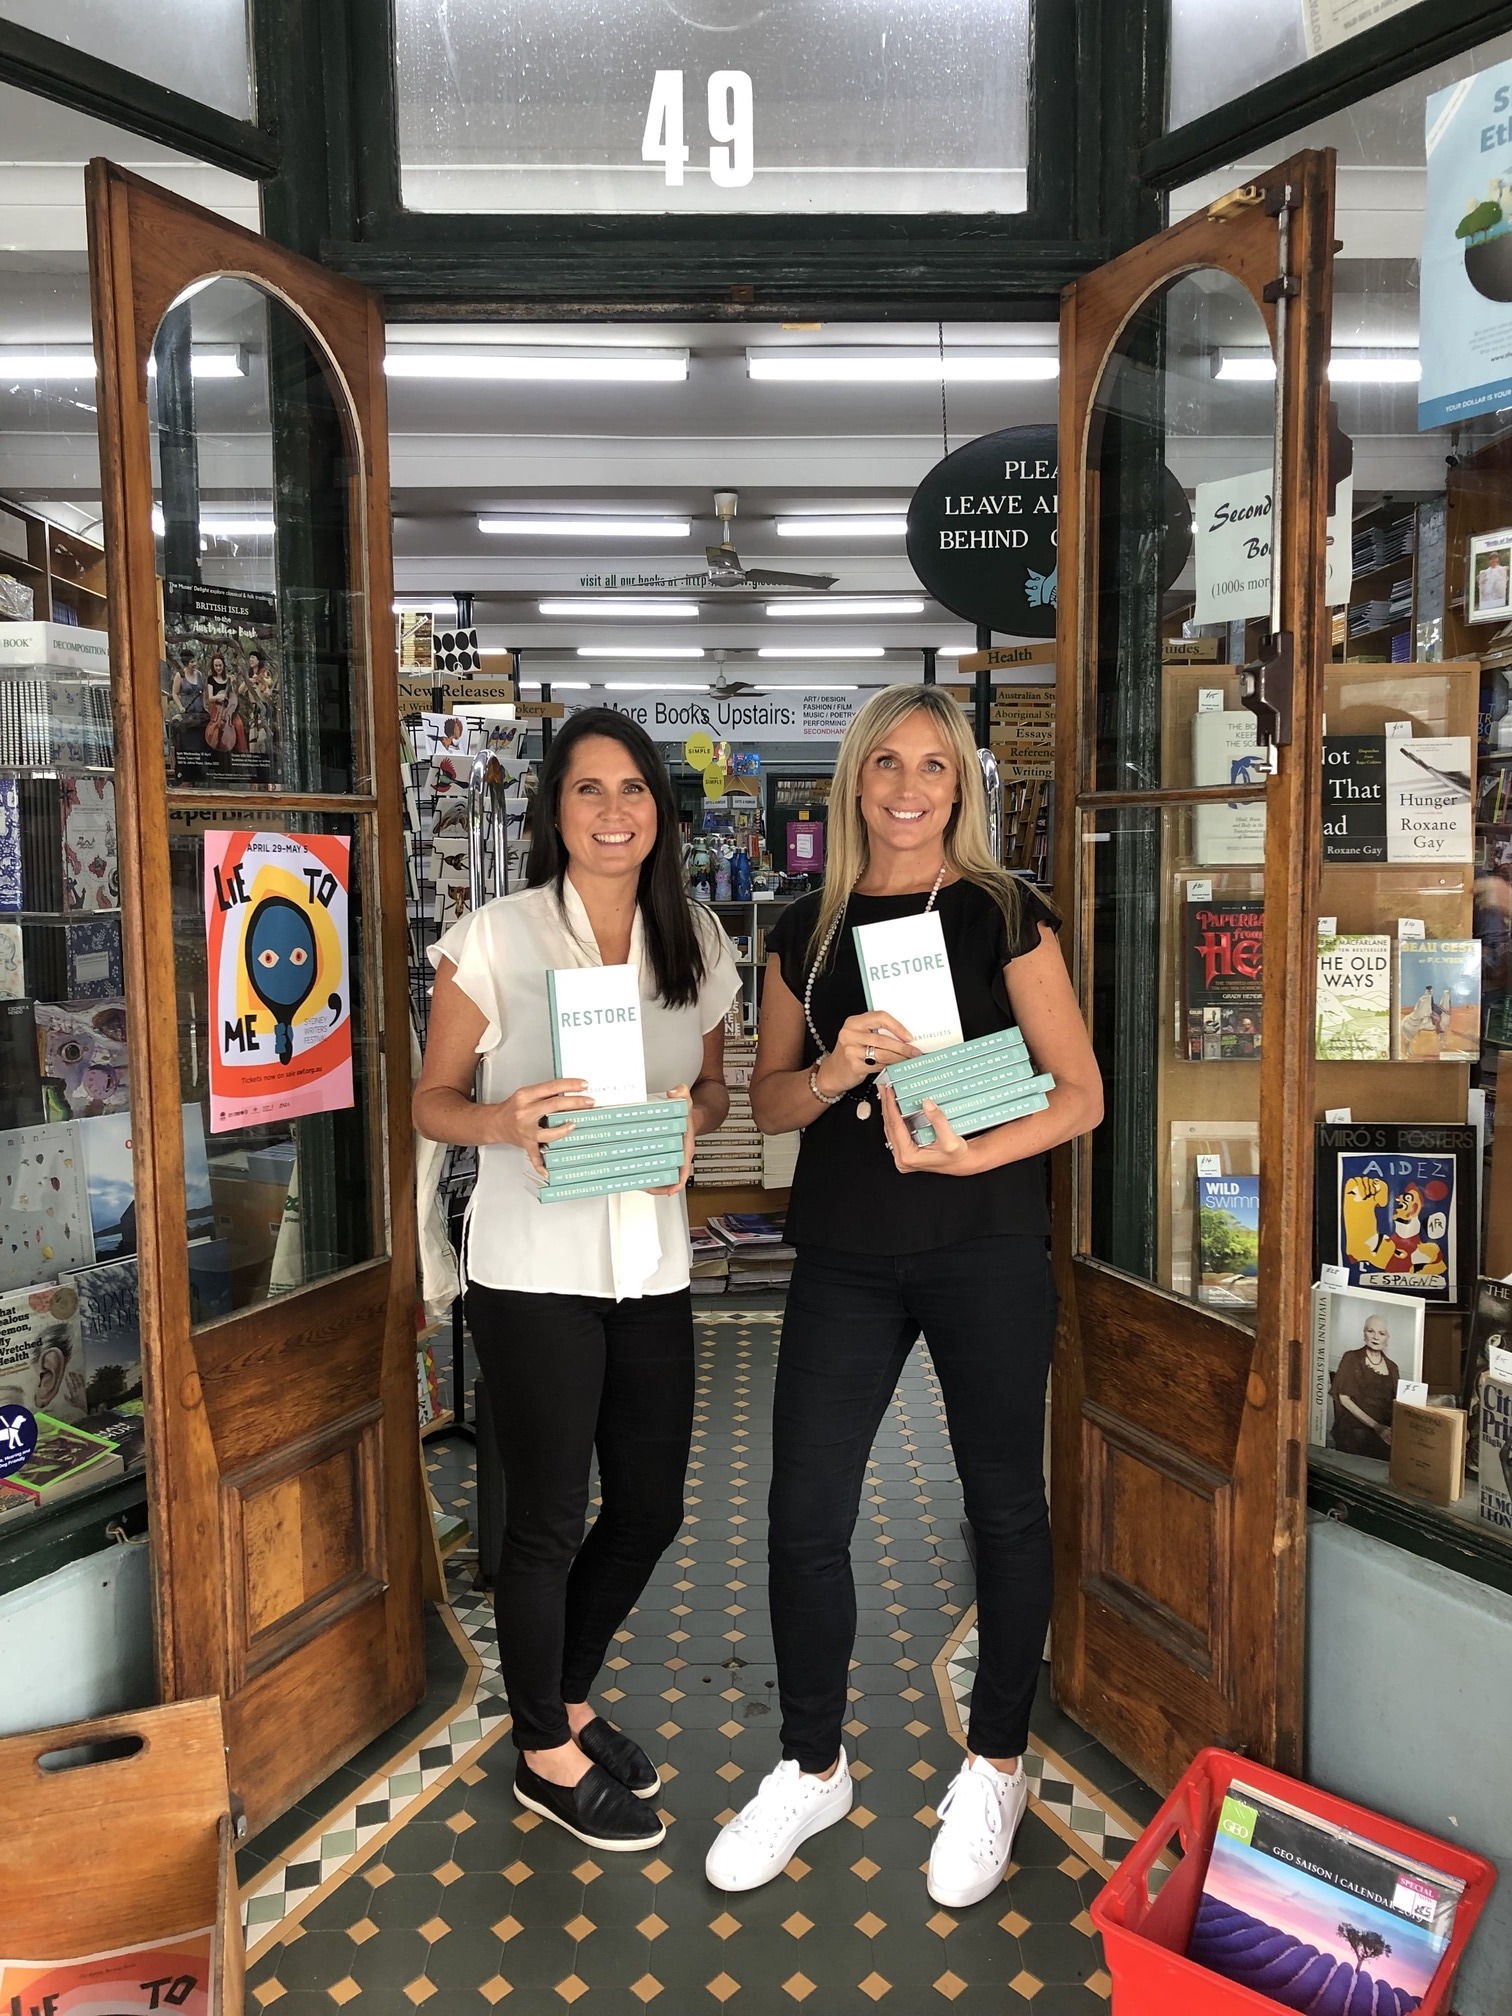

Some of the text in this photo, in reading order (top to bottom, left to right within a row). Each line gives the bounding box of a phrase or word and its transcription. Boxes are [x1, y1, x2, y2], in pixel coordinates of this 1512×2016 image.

[1493, 85, 1512, 113] S
[641, 70, 754, 188] 49
[1445, 389, 1511, 412] YOUR DOLLAR IS YOUR
[944, 495, 1023, 515] LEAVE
[939, 529, 1029, 549] BEHIND
[580, 574, 602, 586] visit
[604, 574, 617, 588] all
[620, 577, 636, 587] our
[195, 601, 249, 616] BRITISH ISLES
[192, 620, 237, 638] Australian
[53, 640, 107, 656] DECOMPOSITION
[987, 648, 1032, 665] Health
[399, 683, 505, 698] New Releases
[998, 691, 1041, 700] Australian
[603, 702, 796, 730] More Books Upstairs:
[994, 711, 1042, 720] Aboriginal
[1016, 729, 1052, 740] Essays
[1228, 723, 1244, 731] THE
[1010, 747, 1055, 757] Referenc
[1226, 740, 1241, 748] THE
[1012, 766, 1053, 778] Writing
[1329, 778, 1381, 799] That
[1400, 793, 1458, 810] Hunger
[1401, 818, 1457, 831] Roxane
[247, 843, 308, 853] APRIL 29-MAY 5
[1327, 845, 1382, 856] Roxane Gay
[1413, 835, 1445, 852] Gay
[213, 862, 338, 912] LIE TO
[869, 953, 945, 982] RESTORE
[1317, 957, 1387, 971] HE OLD
[1323, 974, 1374, 988] WAYS
[304, 1016, 327, 1026] SYDNEY
[561, 1006, 637, 1028] RESTORE
[224, 1014, 260, 1054] ME
[304, 1025, 328, 1035] WRITERS
[903, 1053, 948, 1072] ESSENTIALISTS
[241, 1076, 262, 1084] Tickets
[910, 1071, 954, 1089] ESSENTIALISTS
[945, 1097, 987, 1115] ESSENTIALISTS
[564, 1131, 612, 1142] ESSENTIALISTS
[1397, 1130, 1474, 1149] POSTERS
[561, 1151, 608, 1163] ESSENTIALISTS
[565, 1167, 611, 1179] ESSENTIALISTS
[1362, 1160, 1446, 1179] AIDEZ
[556, 1185, 603, 1197] ESSENTIALISTS
[1206, 1182, 1240, 1195] WILD
[1369, 1273, 1440, 1288] ESPAGNE
[1487, 1284, 1510, 1299] THE
[1317, 1297, 1327, 1345] VIVIENNE
[1315, 1348, 1326, 1405] WESTWOOD
[1222, 1818, 1249, 1839] GEO
[1272, 1846, 1396, 1911] GEO SAISON CALENDAR
[1400, 1877, 1435, 1898] SPECIAL
[139, 1974, 198, 2010] TO
